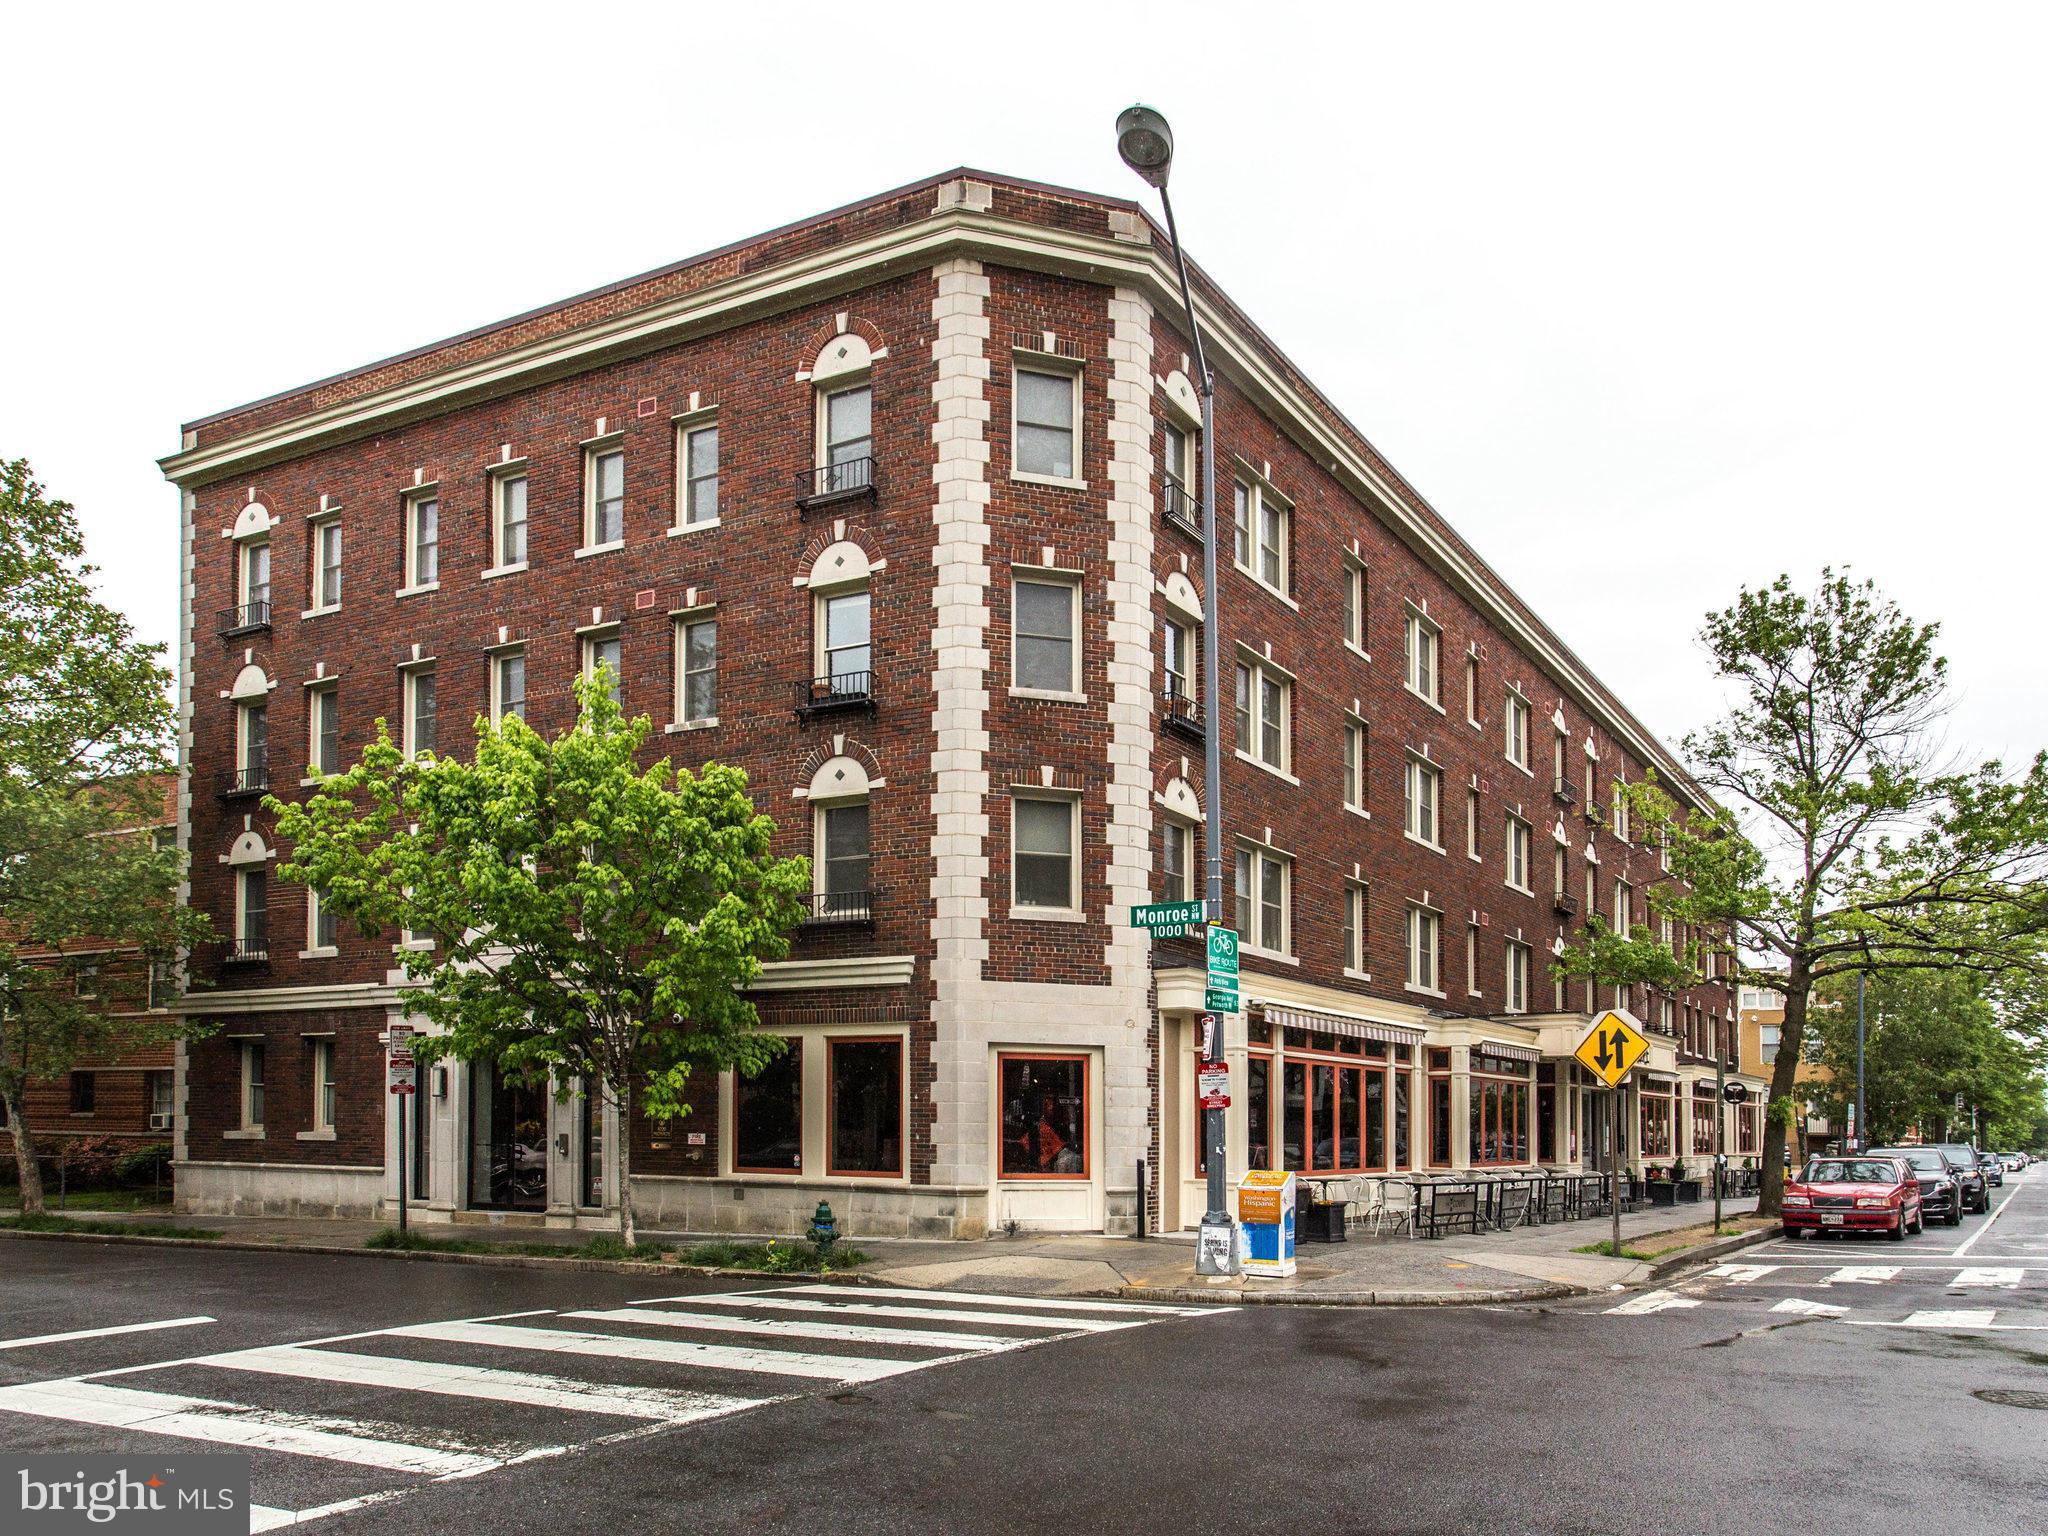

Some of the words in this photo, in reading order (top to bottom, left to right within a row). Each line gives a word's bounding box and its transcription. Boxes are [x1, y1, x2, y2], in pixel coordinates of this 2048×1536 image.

[1191, 904, 1199, 912] ST
[1136, 908, 1188, 924] Monroe
[1191, 912, 1200, 920] NW
[1153, 925, 1182, 937] 1000
[1209, 955, 1220, 964] BIKE
[1221, 957, 1237, 968] ROUTE
[1243, 1199, 1276, 1207] Hispanic
